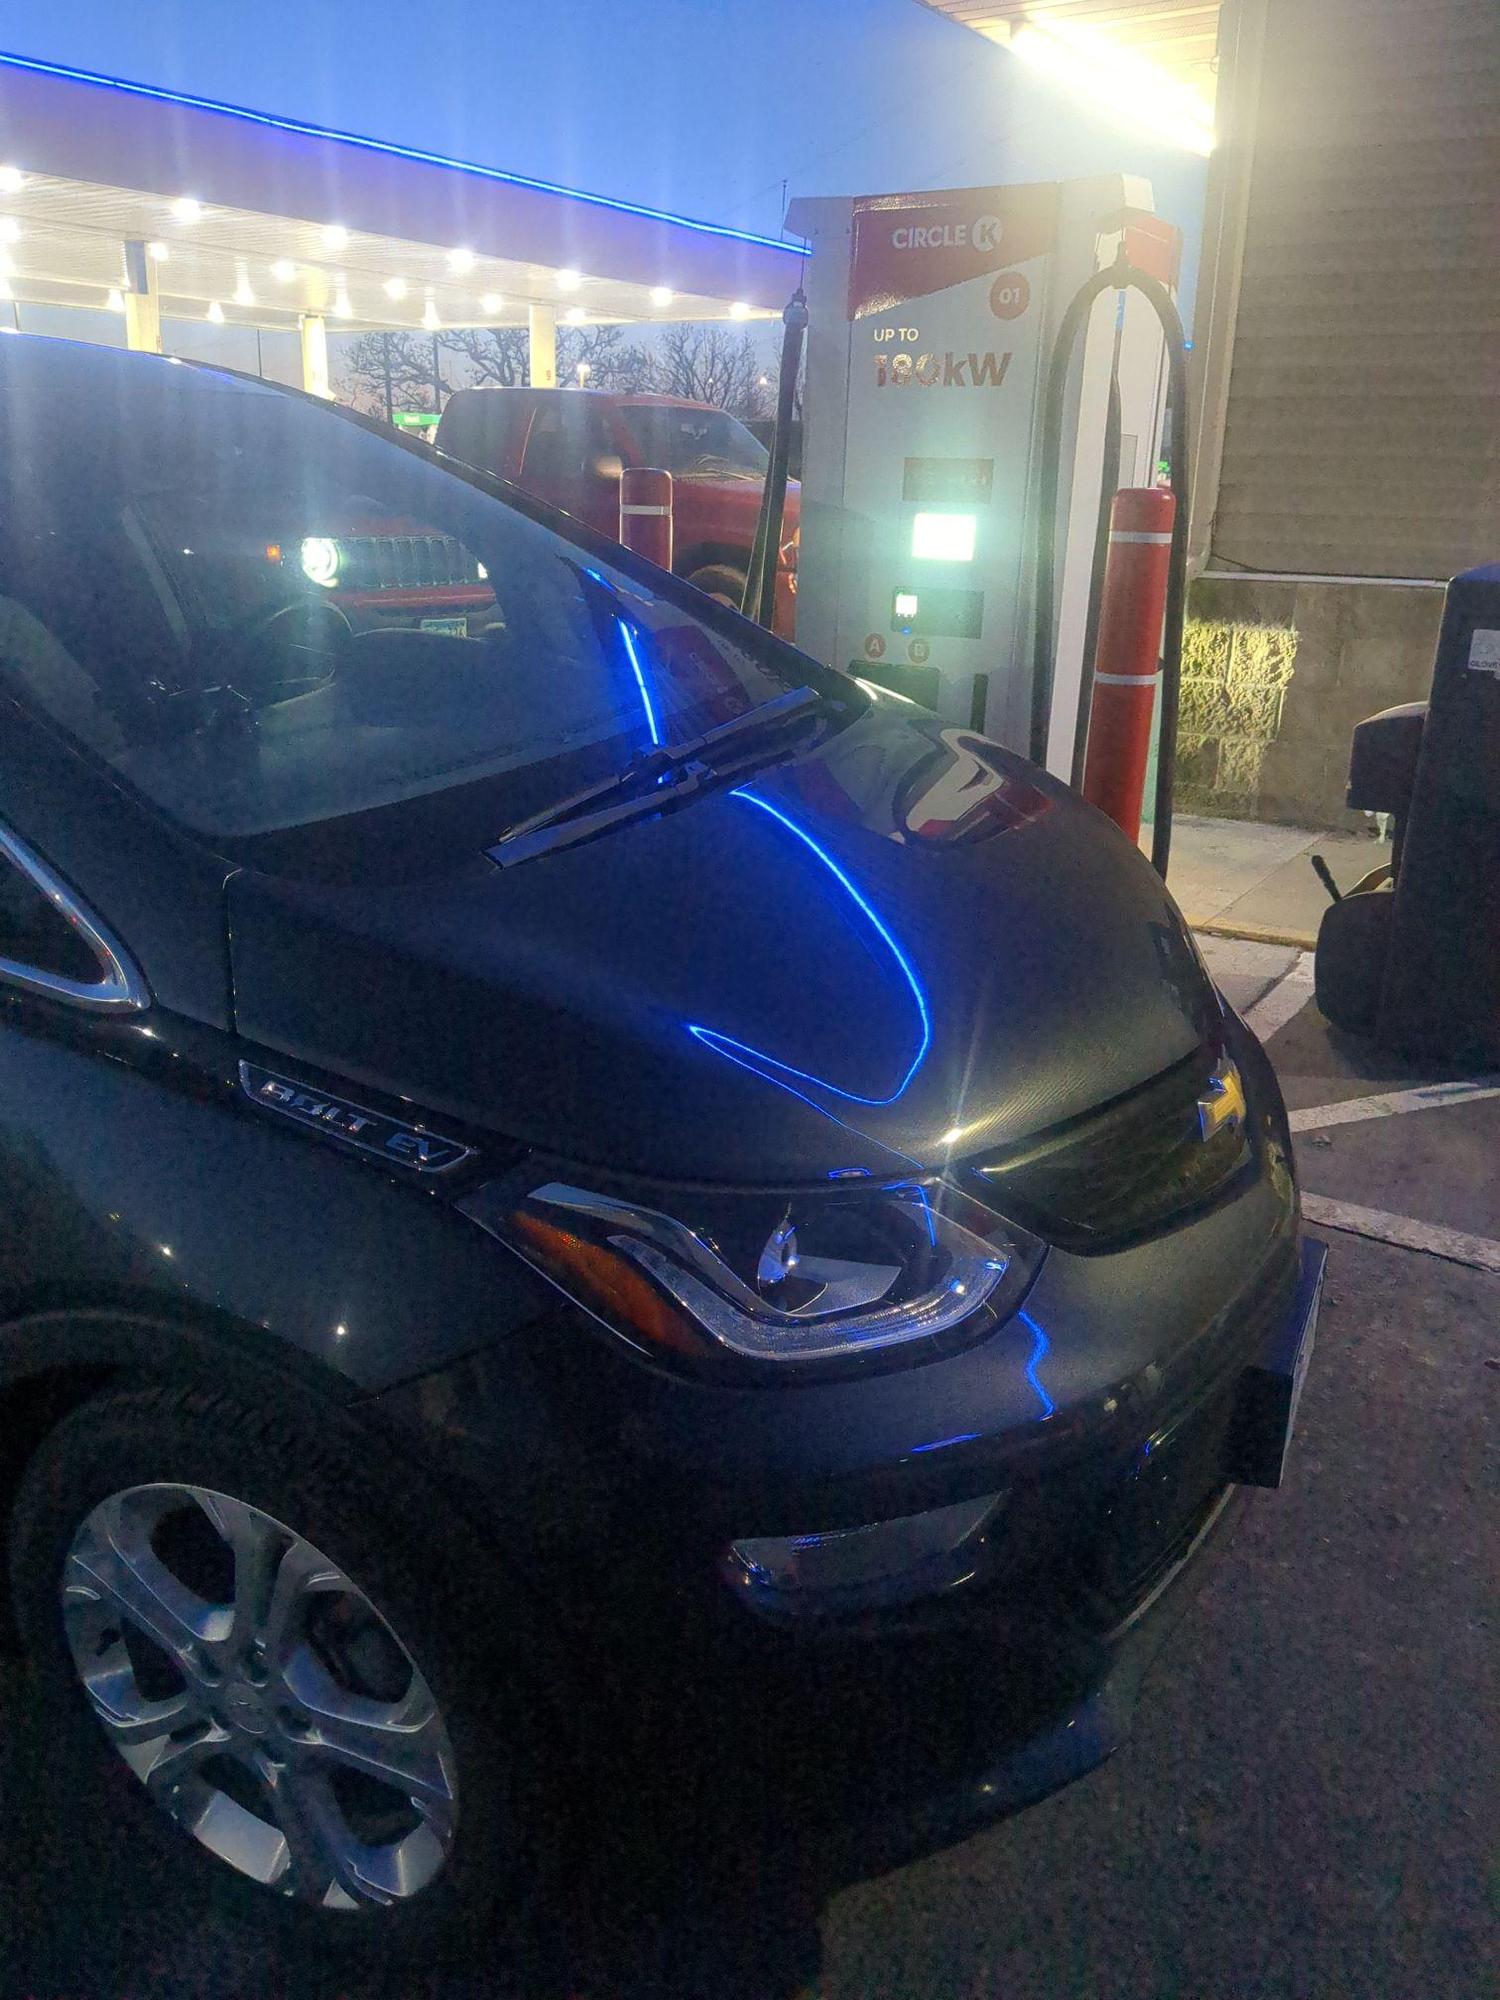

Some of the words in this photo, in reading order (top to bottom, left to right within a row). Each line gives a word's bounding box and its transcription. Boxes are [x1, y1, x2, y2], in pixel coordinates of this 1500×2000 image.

[892, 225, 966, 249] CIRCLE
[973, 216, 1003, 251] K
[1000, 287, 1020, 304] 01
[874, 328, 894, 342] UP
[899, 328, 918, 341] TO
[873, 352, 1012, 387] 180kW
[386, 1132, 450, 1161] EV
